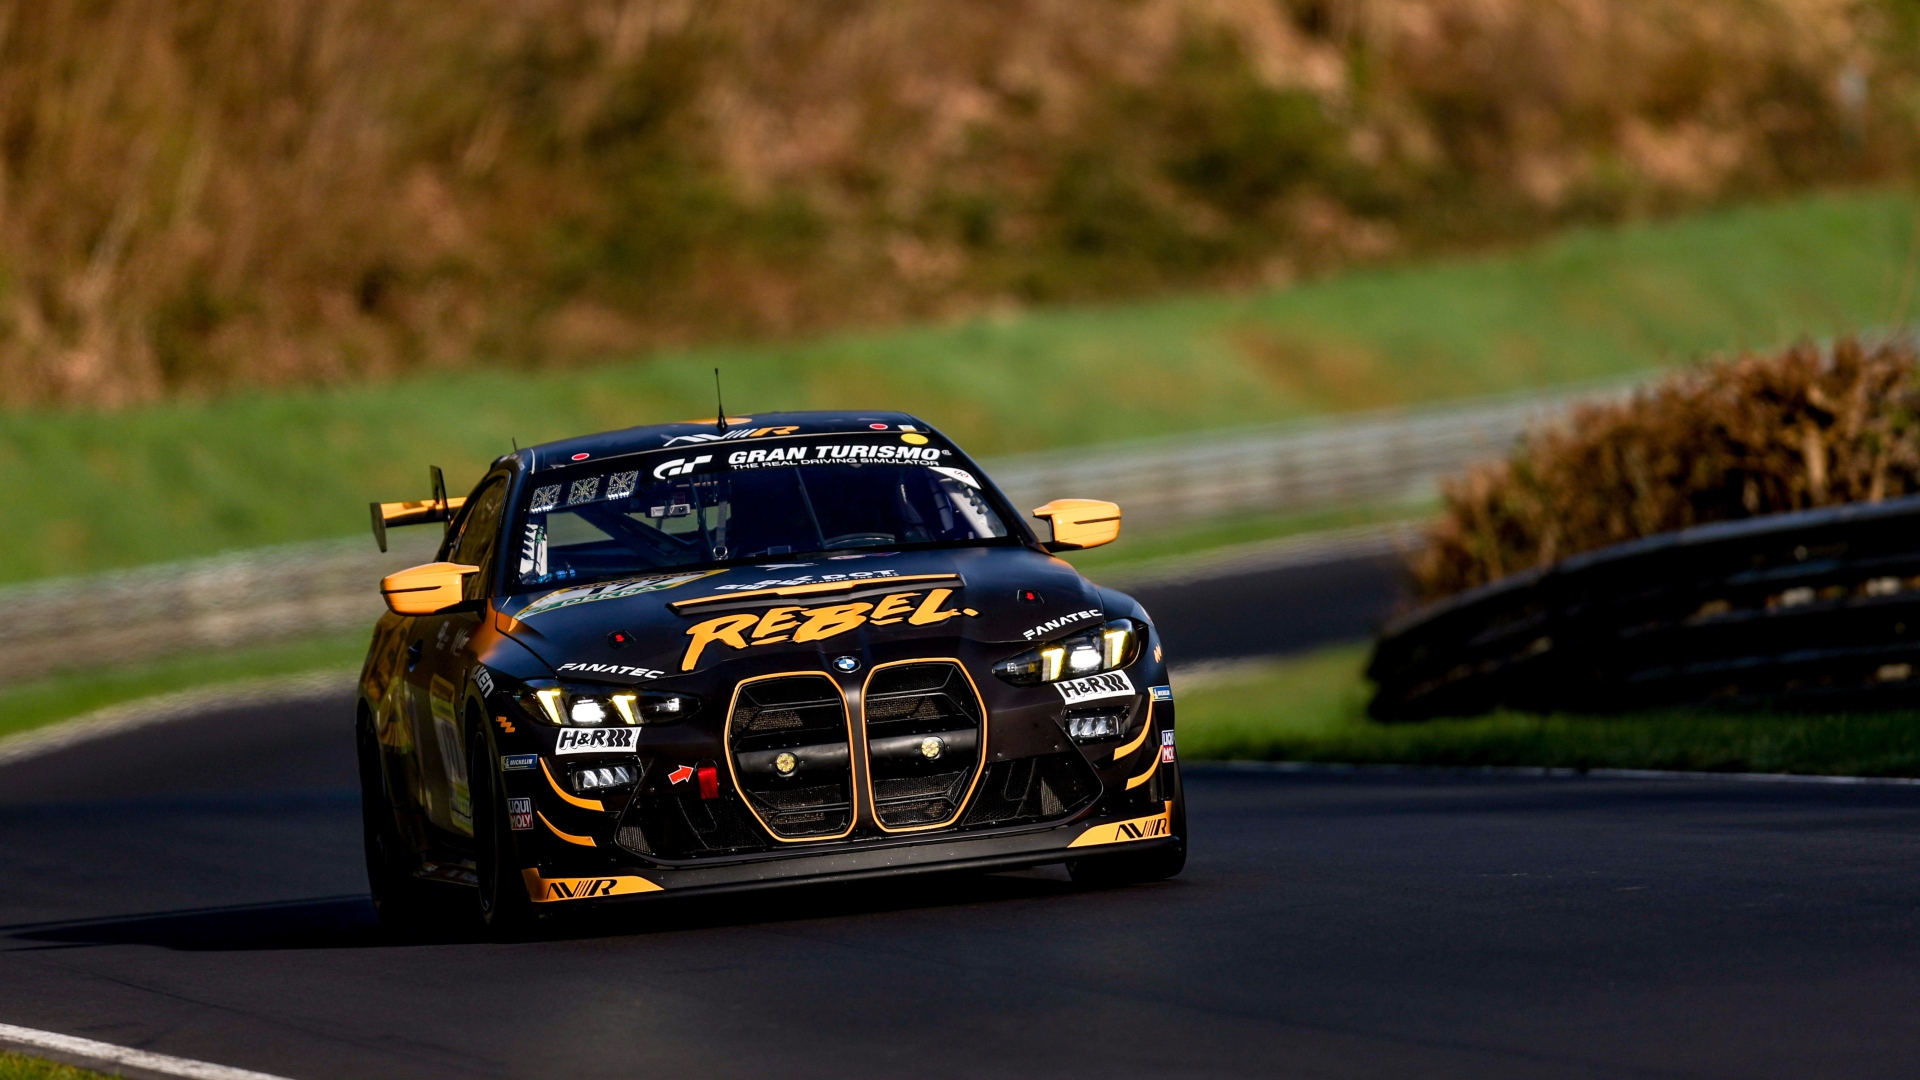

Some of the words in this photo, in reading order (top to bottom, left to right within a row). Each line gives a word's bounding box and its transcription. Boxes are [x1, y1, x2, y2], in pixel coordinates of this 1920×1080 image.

[728, 447, 808, 465] GRAN
[815, 445, 941, 460] TURISMO
[730, 462, 759, 470] THE
[801, 457, 857, 465] DRIVING
[861, 458, 939, 467] SIMULATOR
[1023, 609, 1103, 641] FANATEC
[557, 662, 665, 679] FANATEC
[510, 758, 533, 766] MICHELIN
[508, 800, 529, 813] LIQUI
